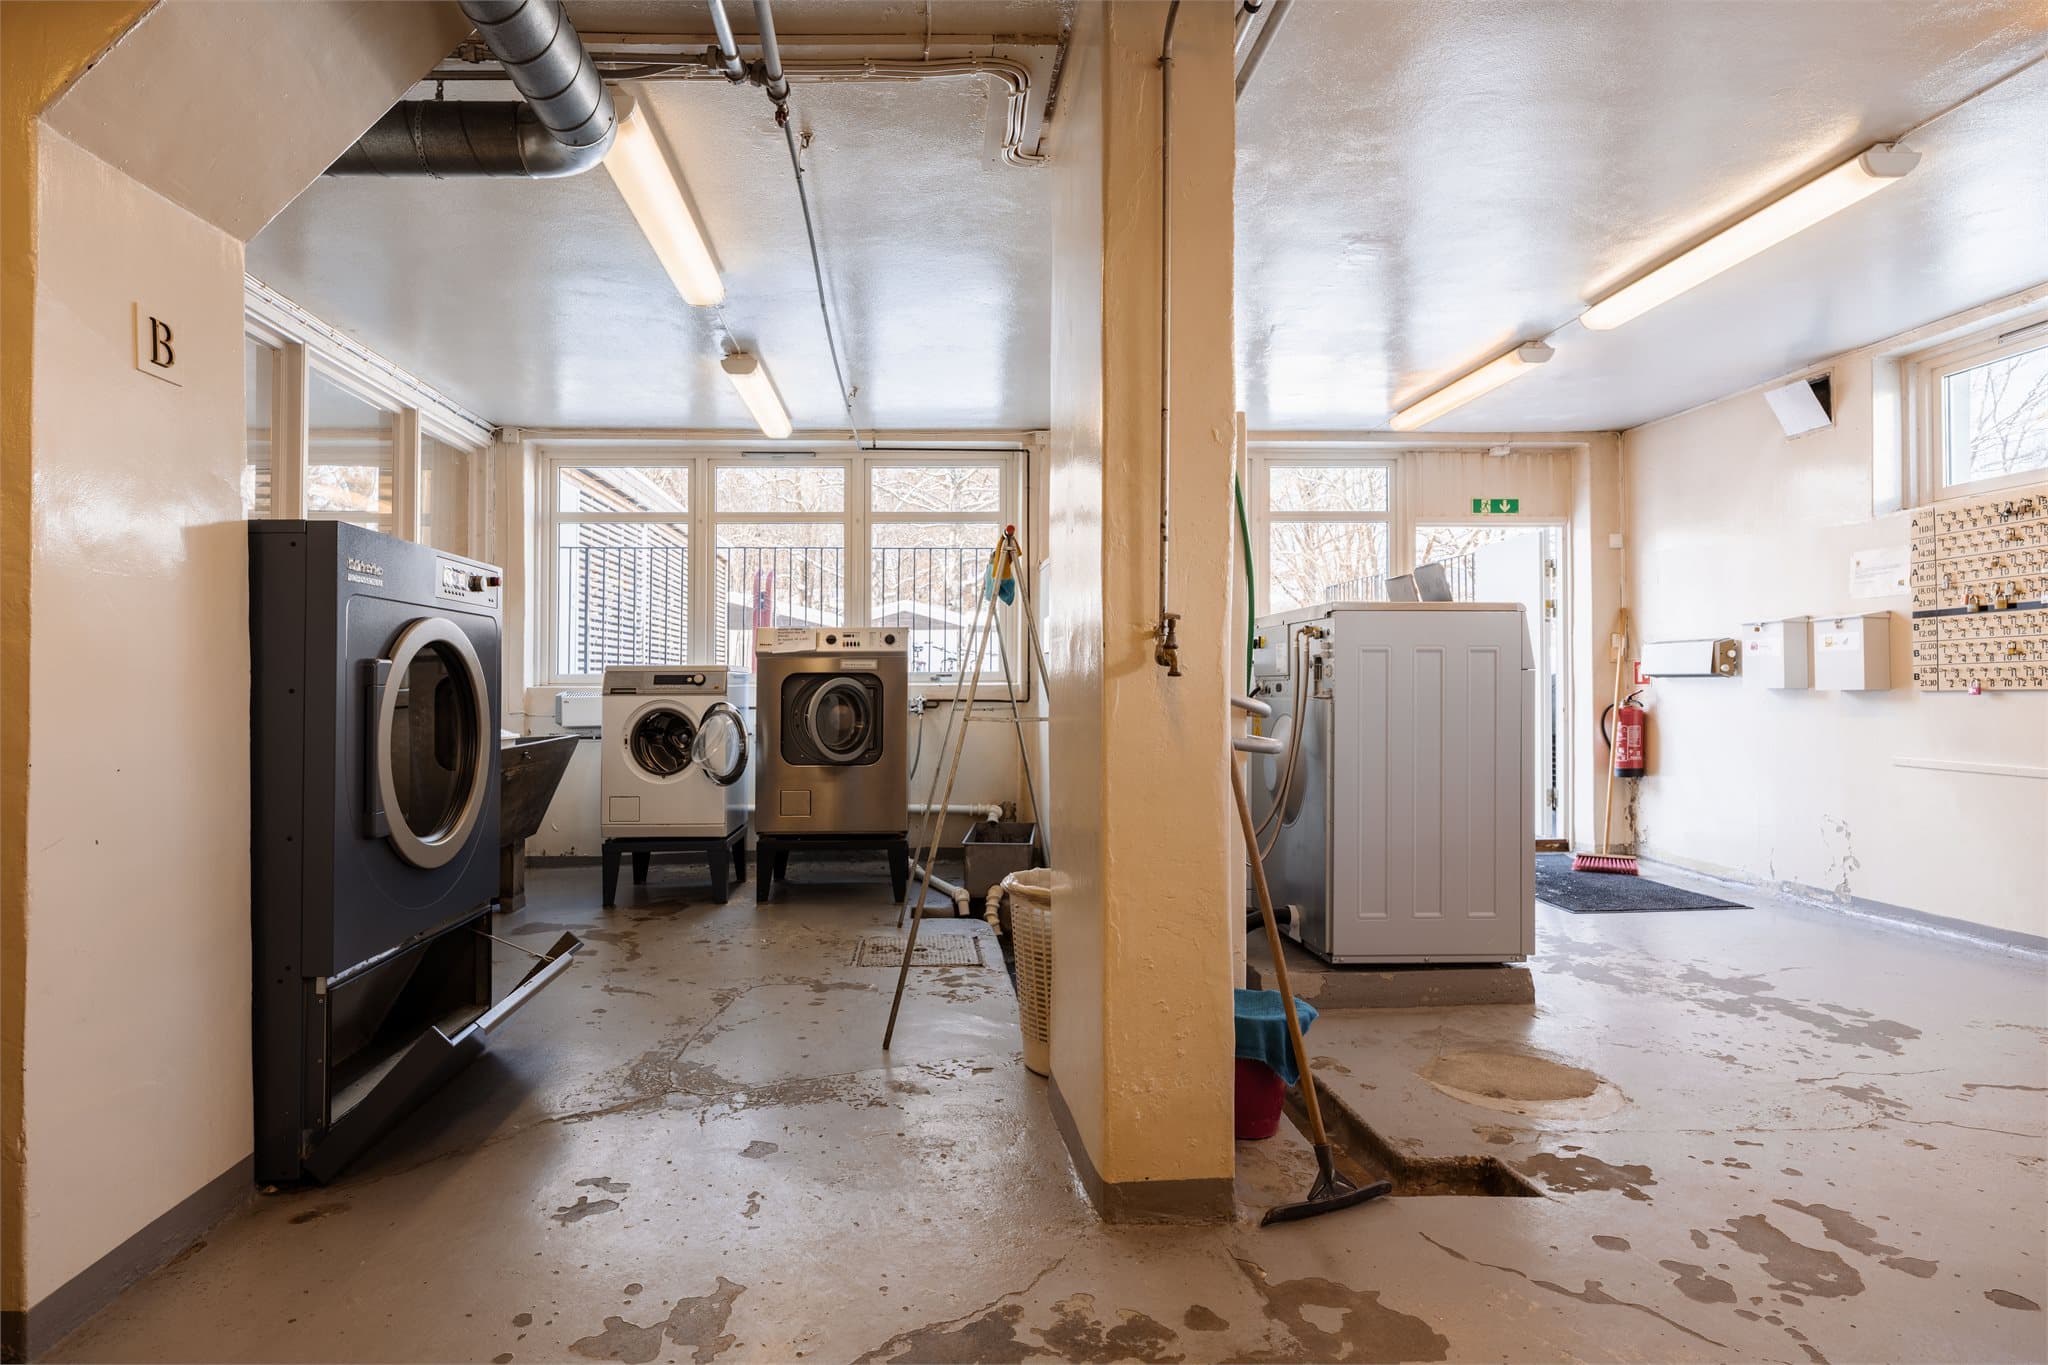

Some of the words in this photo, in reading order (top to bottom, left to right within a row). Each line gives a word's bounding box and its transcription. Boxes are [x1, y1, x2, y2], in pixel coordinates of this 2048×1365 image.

[149, 316, 175, 368] B
[1914, 649, 1920, 658] B
[1914, 673, 1920, 681] B
